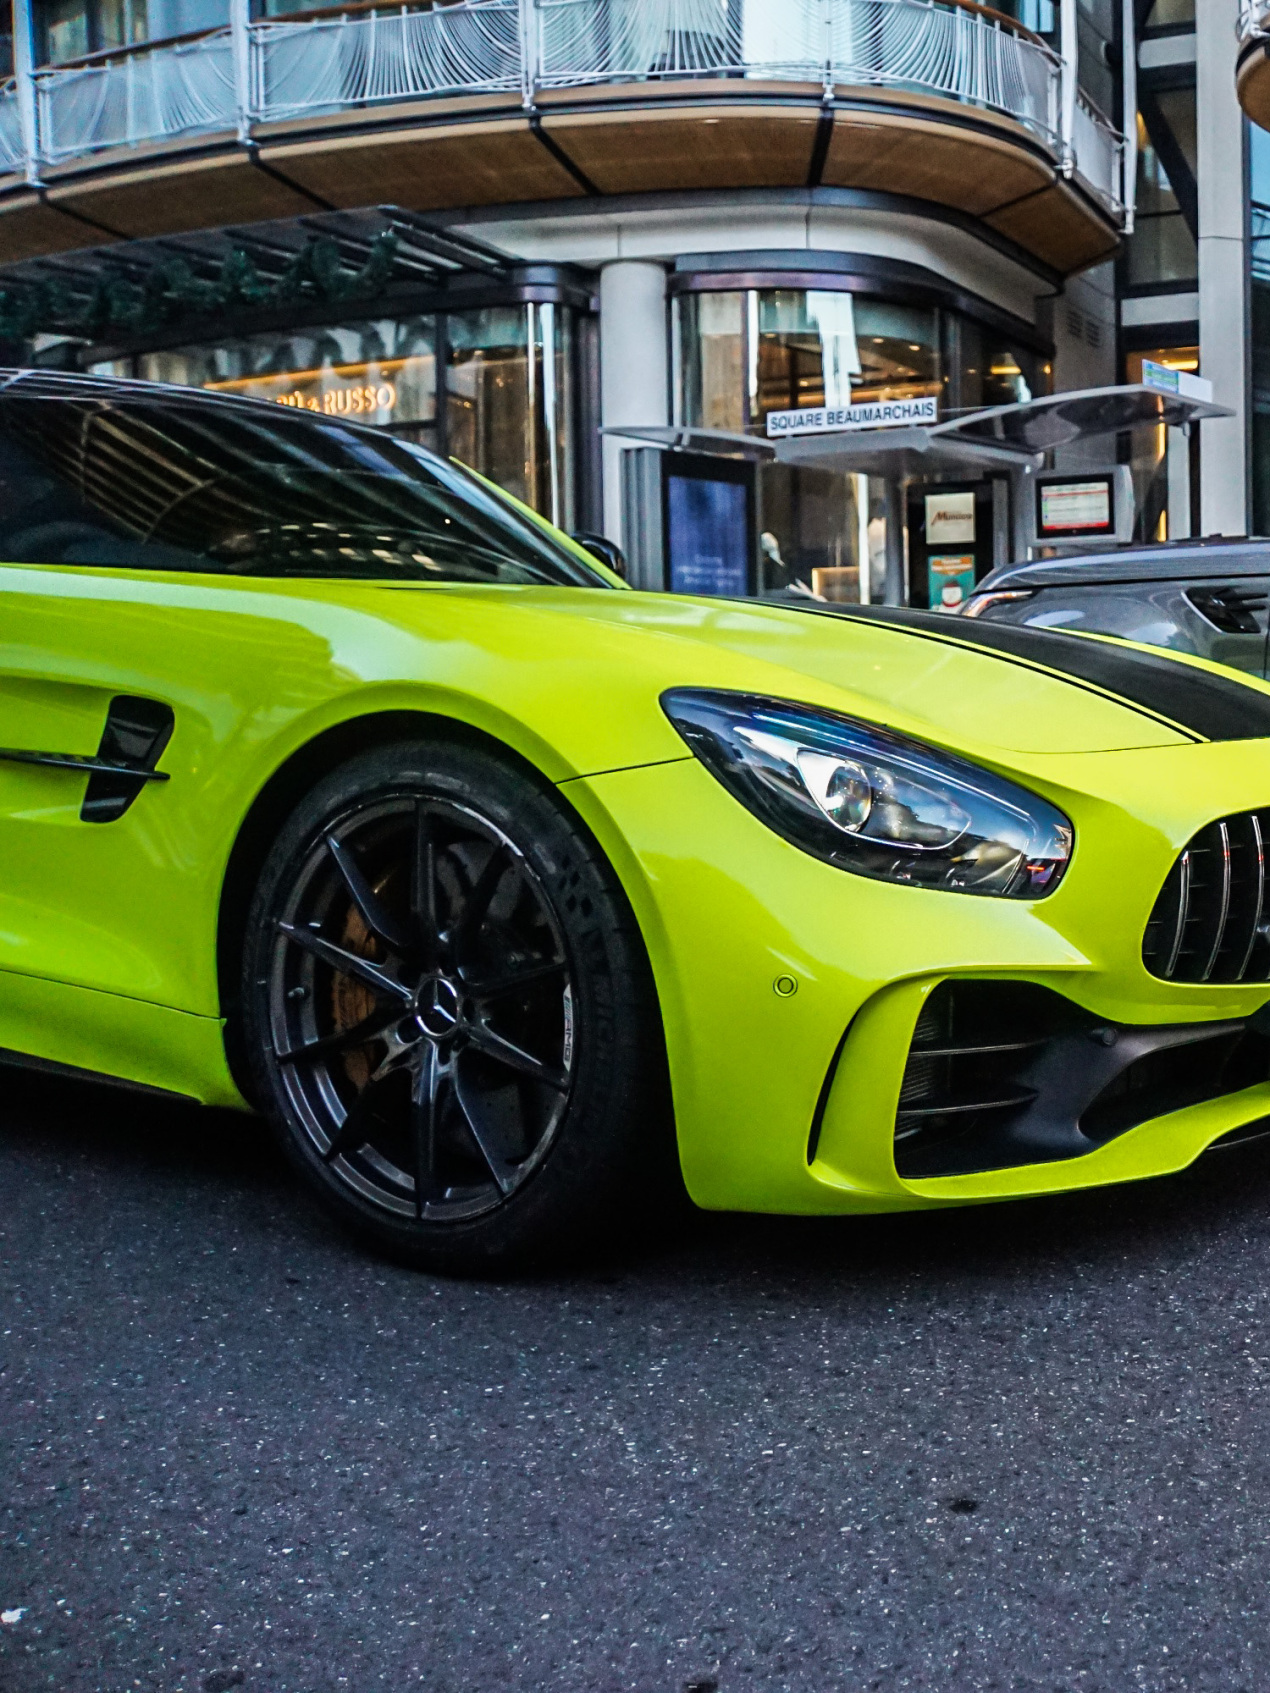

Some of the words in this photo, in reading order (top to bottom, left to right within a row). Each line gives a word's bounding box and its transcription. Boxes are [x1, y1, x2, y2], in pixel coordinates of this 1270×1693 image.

[324, 383, 396, 415] RUSSO
[770, 412, 823, 431] SQUARE
[826, 402, 934, 425] BEAUMARCHAIS
